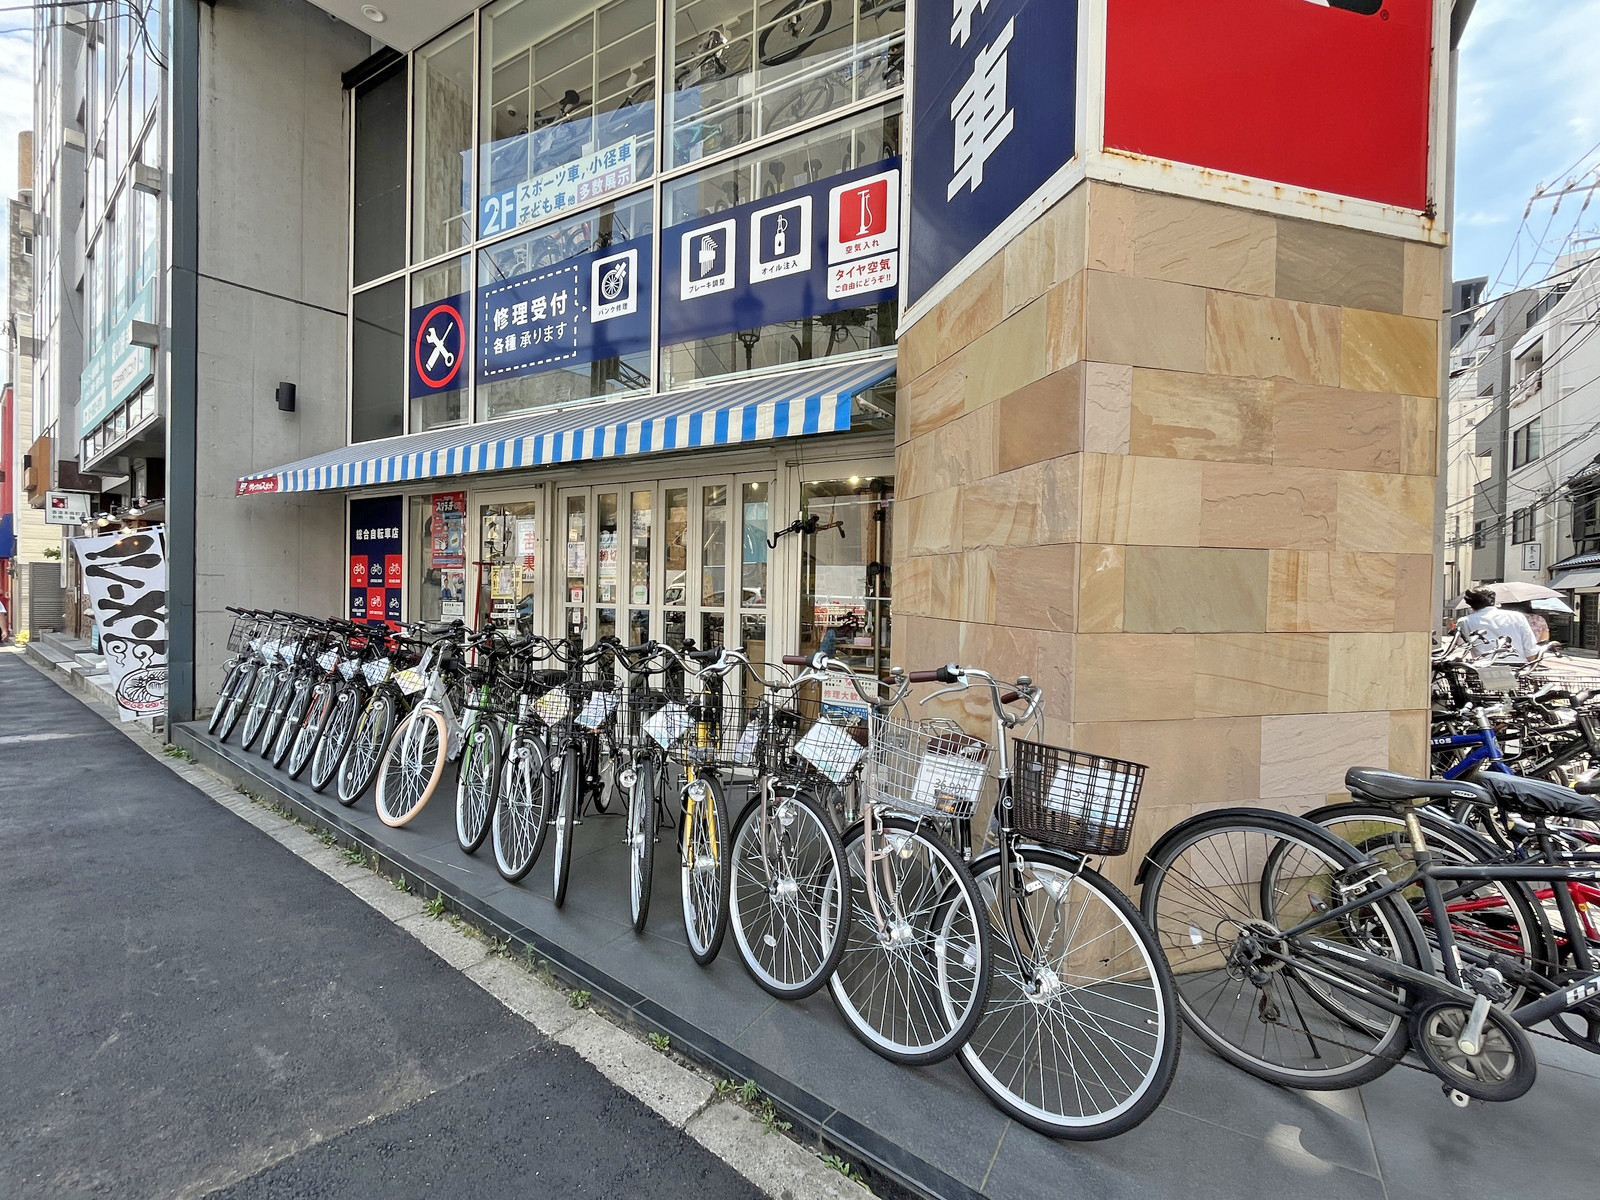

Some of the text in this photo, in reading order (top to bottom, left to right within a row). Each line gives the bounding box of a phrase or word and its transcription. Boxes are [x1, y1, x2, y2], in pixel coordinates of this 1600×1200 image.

[579, 168, 630, 200] 多数展示
[483, 191, 514, 236] 2F
[845, 240, 880, 254] 空気入れ
[761, 259, 798, 275] オイル注入
[835, 258, 891, 281] タイヤ空気
[688, 278, 726, 294] ブレーキ調整
[493, 289, 568, 332] 修理受付
[598, 302, 628, 316] パンク修理
[355, 526, 399, 541] 総合自転車店
